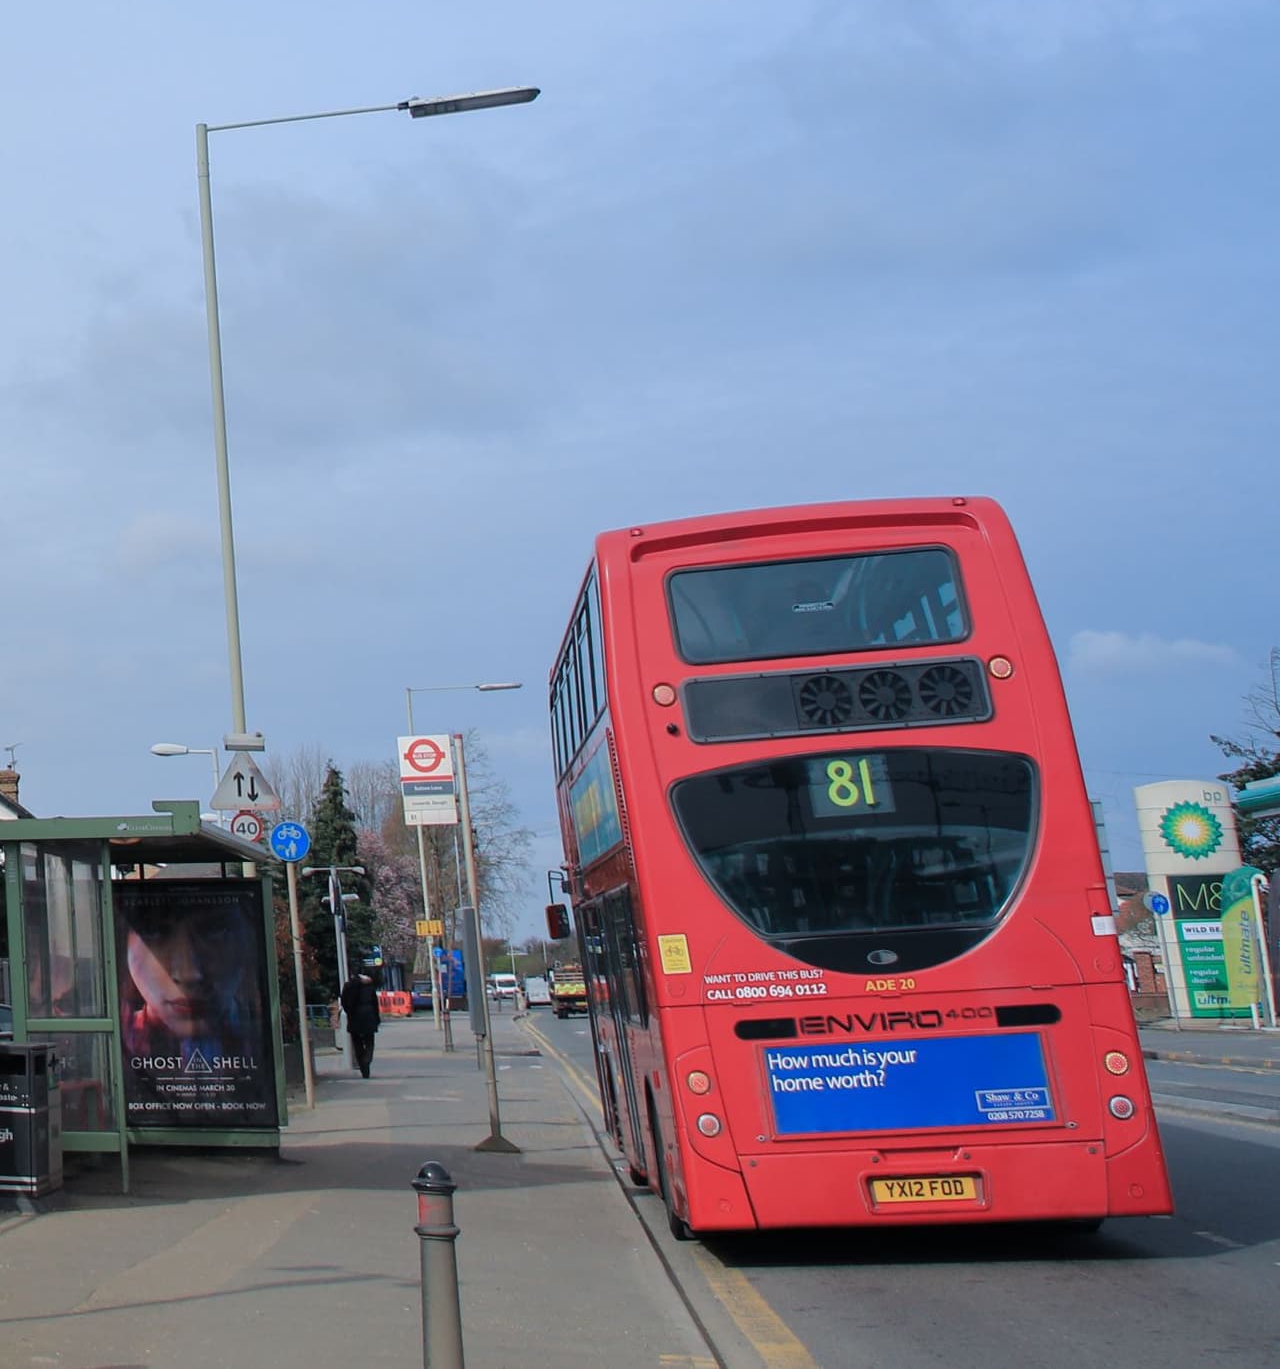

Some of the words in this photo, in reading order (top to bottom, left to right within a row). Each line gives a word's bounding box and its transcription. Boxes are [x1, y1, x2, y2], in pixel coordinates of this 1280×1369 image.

[827, 758, 875, 807] 81
[1202, 789, 1222, 805] bp
[236, 821, 258, 835] 40
[1241, 910, 1252, 975] ultimate
[704, 975, 731, 984] WANT
[733, 973, 747, 982] TO
[748, 972, 776, 981] DRIVE
[777, 970, 799, 980] THIS
[800, 969, 824, 978] BUS?
[865, 980, 897, 991] ADE
[899, 978, 916, 990] 20
[707, 990, 734, 1000] CALL
[736, 986, 767, 999] 0800
[769, 985, 793, 997] 694
[795, 983, 827, 995] 0112
[799, 1009, 943, 1035] ENVIRO
[130, 1057, 183, 1070] GHOST
[213, 1056, 258, 1069] SHELL
[767, 1053, 808, 1070] How
[811, 1048, 861, 1067] much
[862, 1048, 876, 1066] is
[876, 1050, 917, 1068] your
[3, 1083, 9, 1091] &
[772, 1074, 824, 1092] home
[826, 1070, 886, 1089] worth?
[985, 1093, 1010, 1102] Shaw
[1013, 1092, 1022, 1101] &
[1024, 1091, 1039, 1100] Co
[1008, 1111, 1023, 1119] 570
[885, 1181, 925, 1198] YX12
[929, 1180, 964, 1196] FOD
